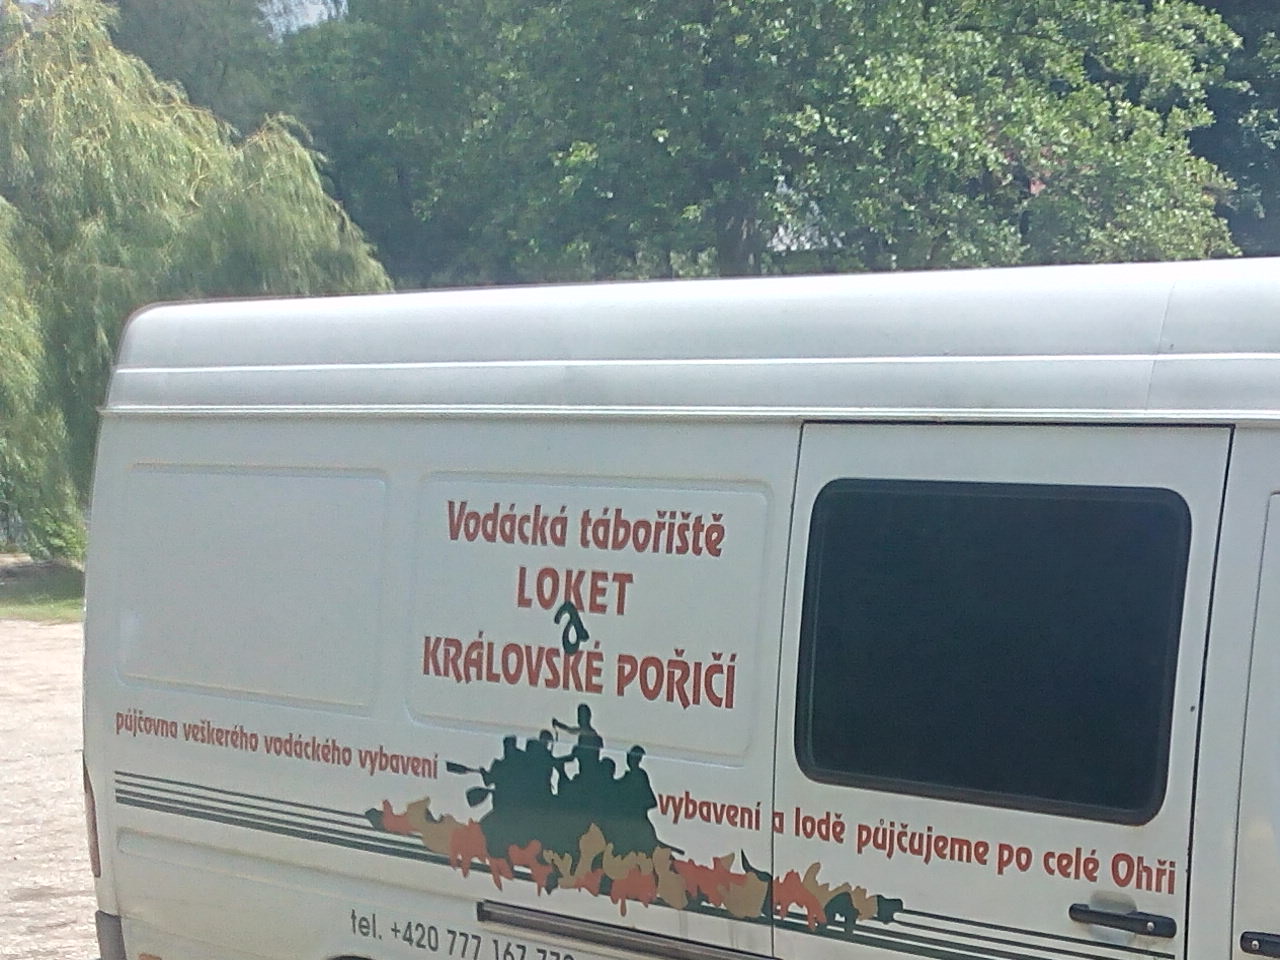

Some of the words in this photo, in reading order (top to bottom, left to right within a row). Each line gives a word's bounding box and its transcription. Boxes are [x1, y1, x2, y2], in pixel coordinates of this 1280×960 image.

[447, 499, 568, 548] Vodácká
[580, 507, 726, 558] tábořiště
[516, 566, 634, 616] LOKET
[422, 630, 604, 695] KRÁLOVSKÉ
[616, 647, 738, 710] POŘIČÍ
[182, 718, 259, 753] veškerého
[264, 731, 352, 767] vodáckého
[358, 744, 439, 780] vybavení
[658, 791, 761, 831] vybavení
[773, 811, 785, 834] a
[794, 806, 846, 845] lodě
[857, 817, 988, 866] půjčujeme
[998, 842, 1034, 875] po
[1043, 847, 1100, 883] celé
[351, 909, 382, 941] tel.
[390, 921, 439, 952] +420
